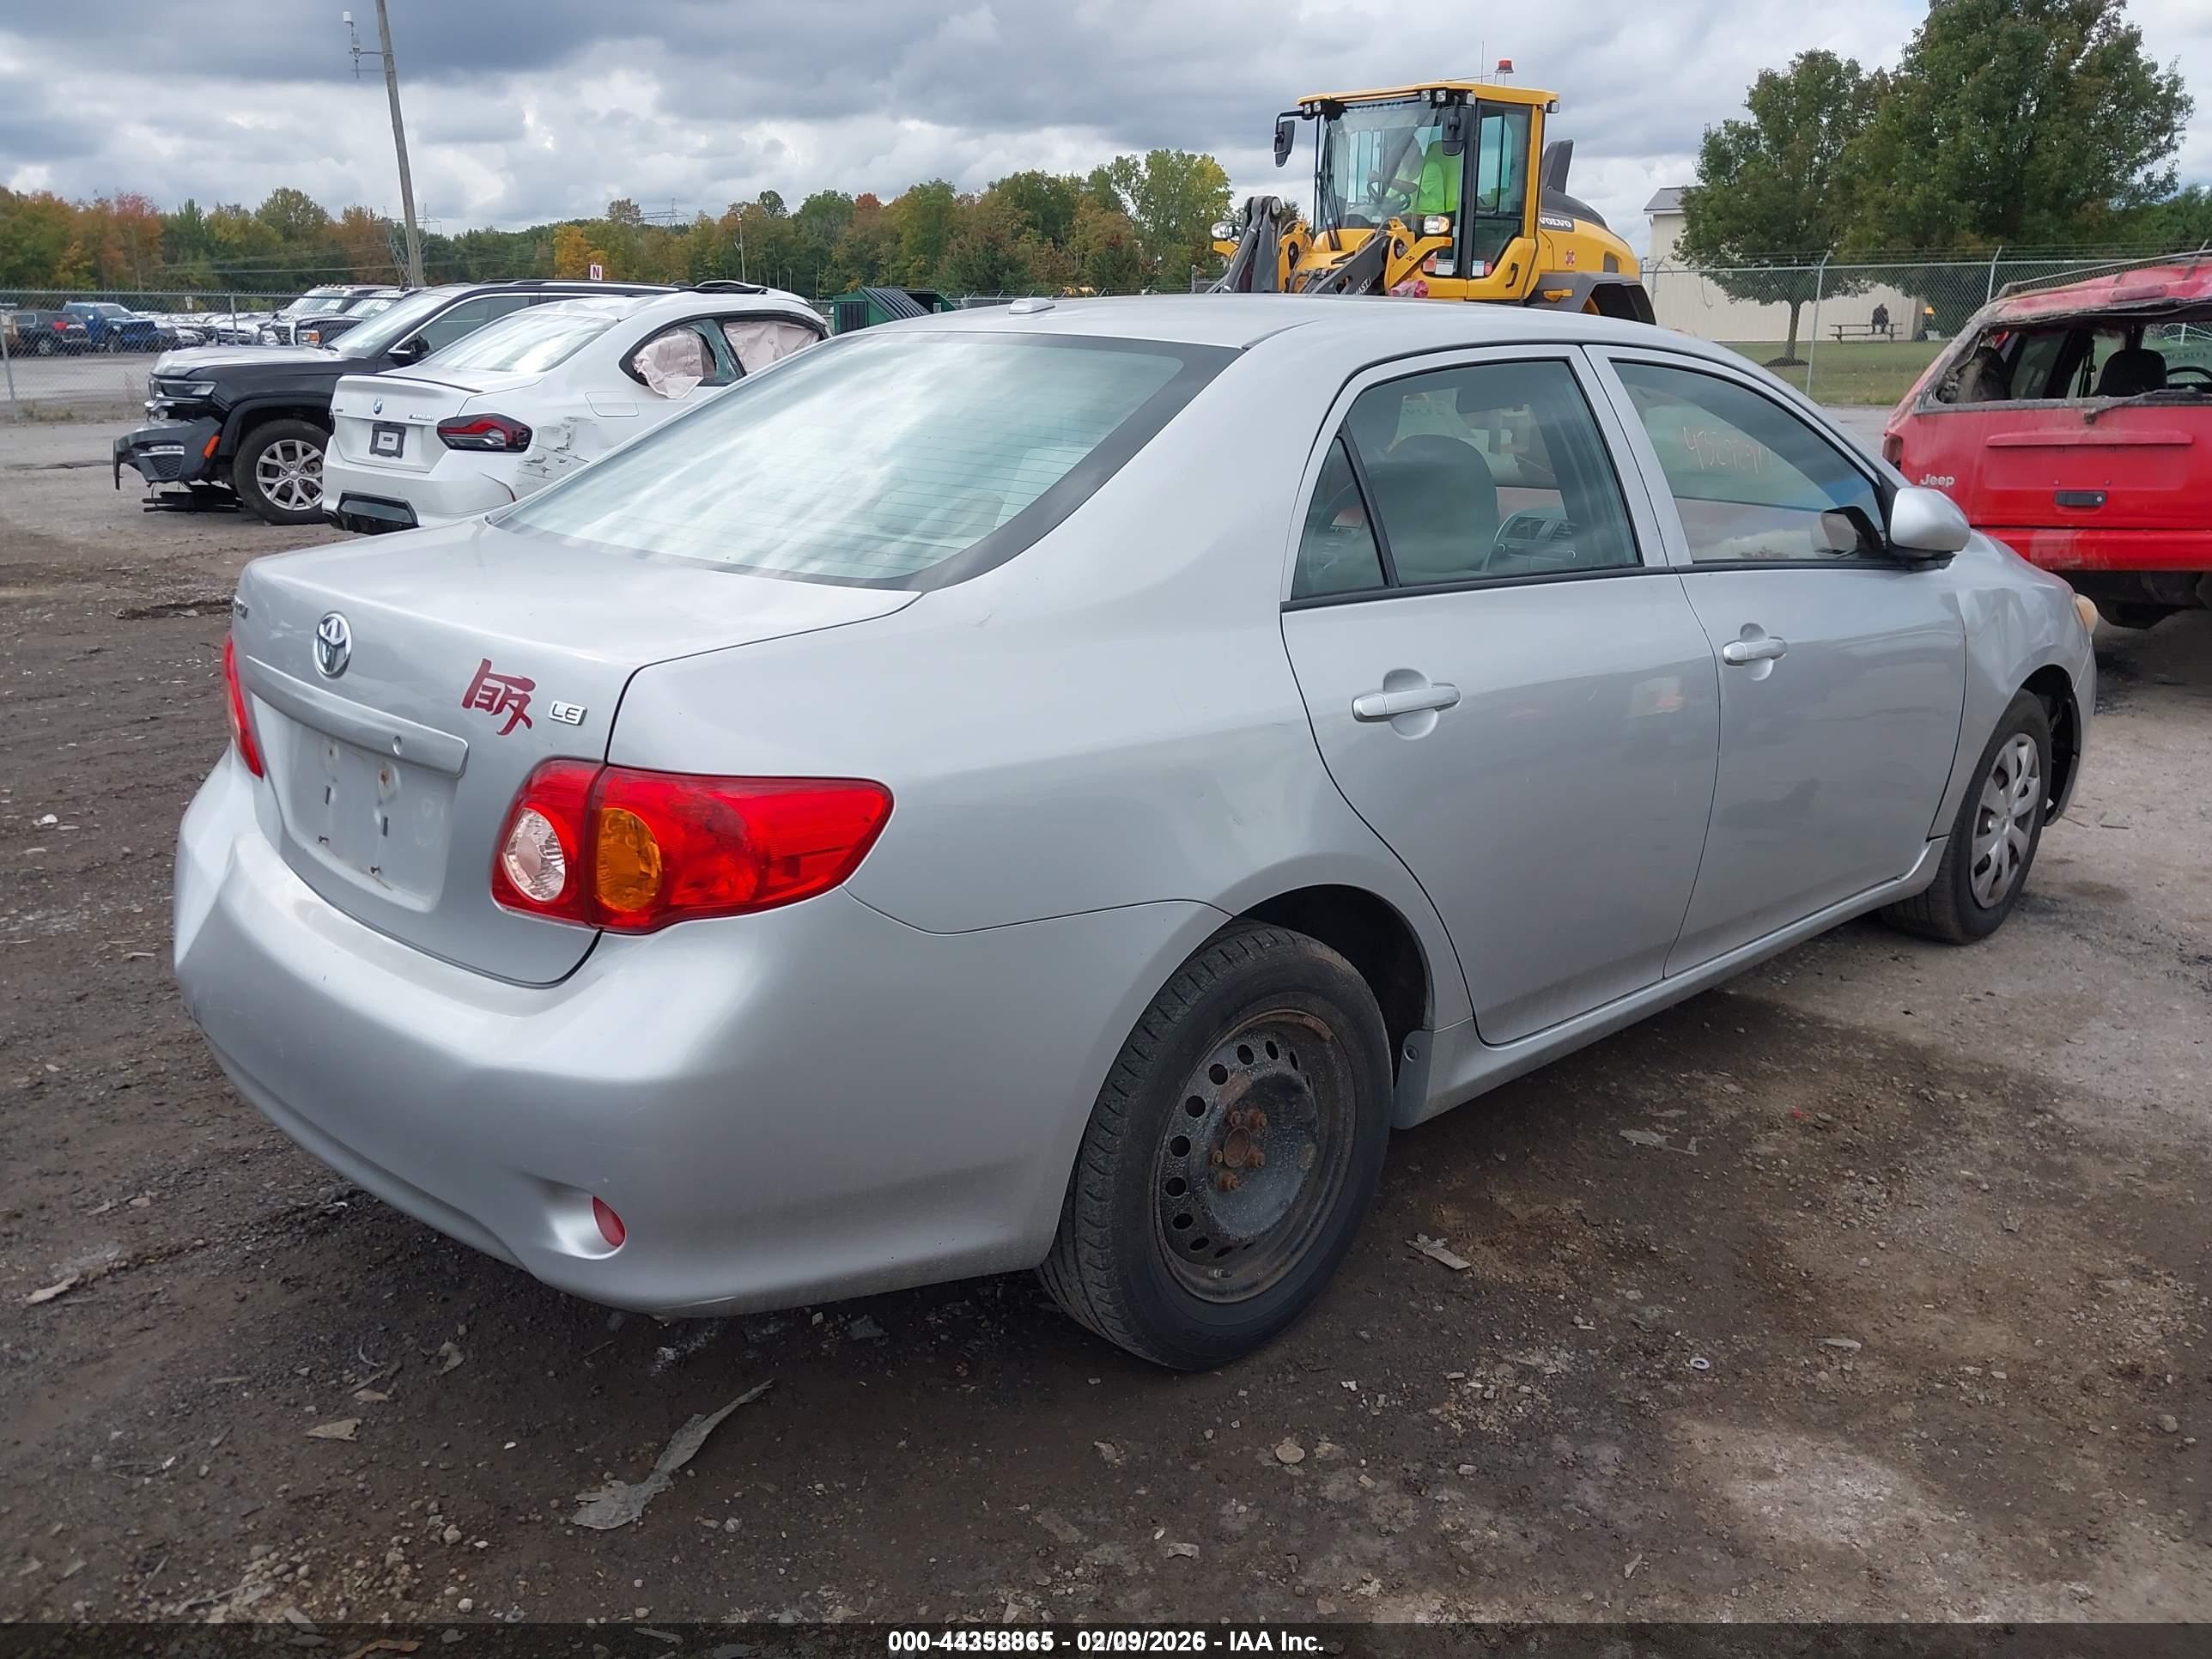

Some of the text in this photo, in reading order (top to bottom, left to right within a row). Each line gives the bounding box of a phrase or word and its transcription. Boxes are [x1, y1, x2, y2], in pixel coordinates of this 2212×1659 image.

[1539, 216, 1572, 228] VOLVO
[592, 266, 599, 278] N
[1919, 473, 1955, 488] Jeep
[551, 703, 580, 721] LE
